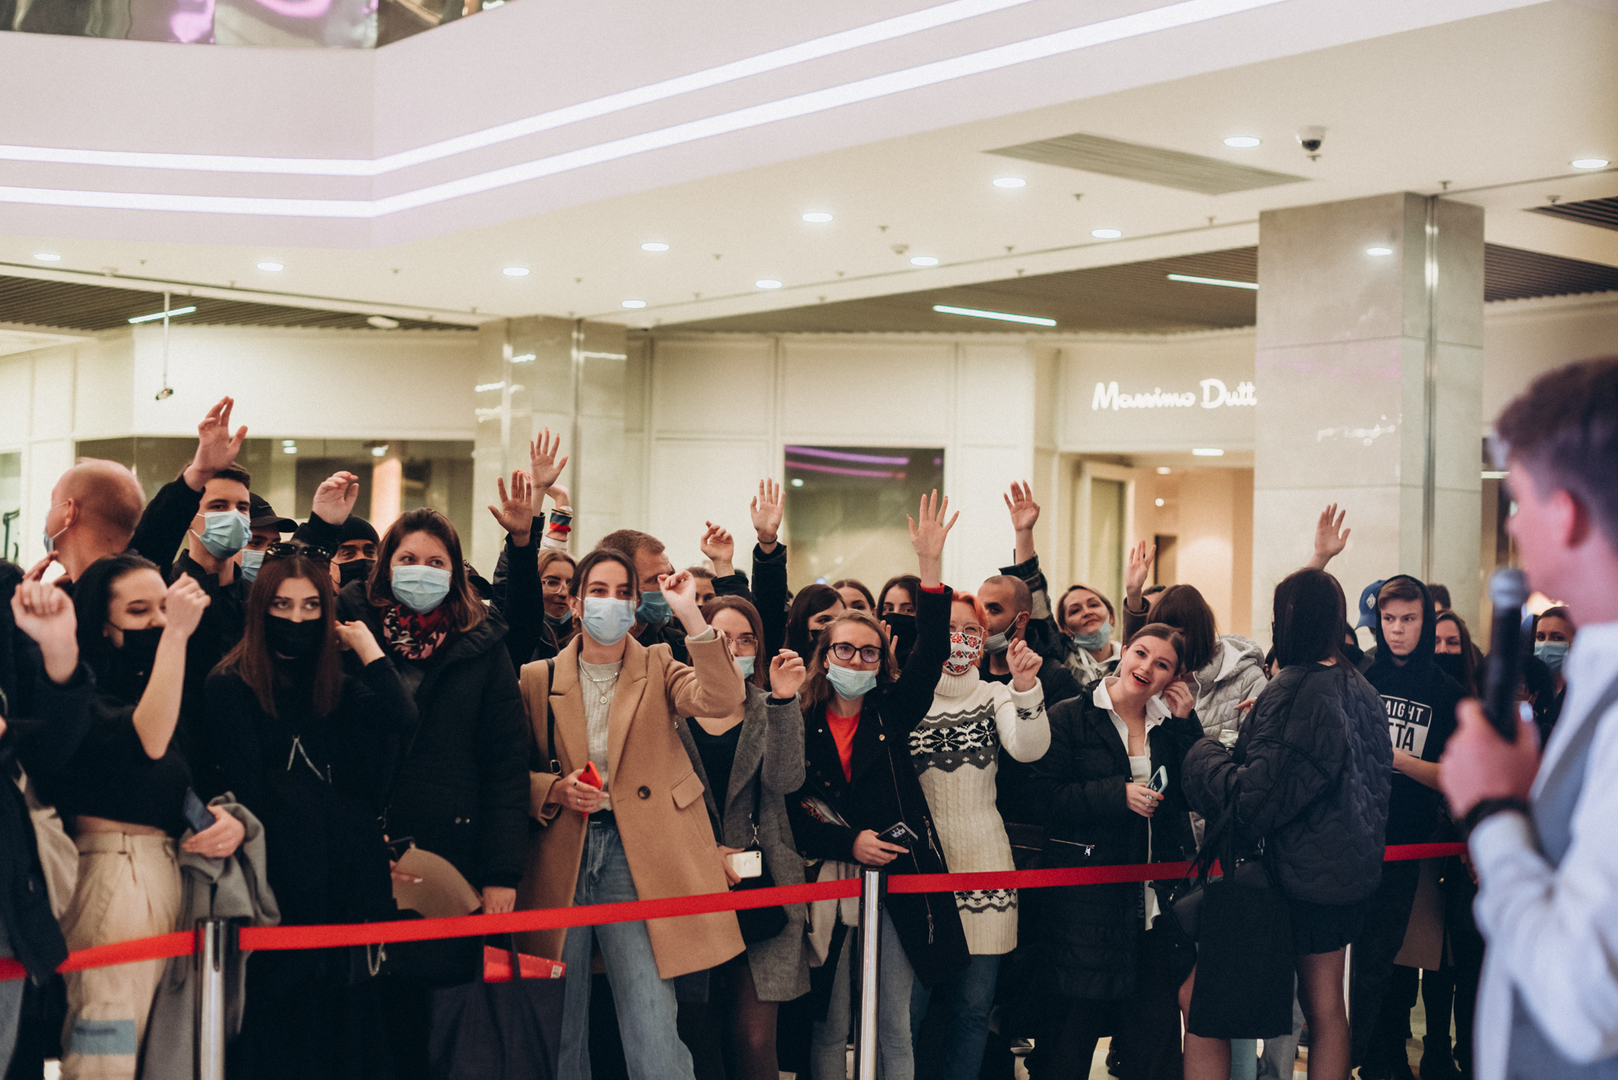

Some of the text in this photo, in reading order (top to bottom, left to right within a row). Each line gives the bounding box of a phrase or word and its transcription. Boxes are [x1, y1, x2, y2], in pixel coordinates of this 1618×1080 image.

[1092, 378, 1258, 411] Massimo Dutt
[1385, 700, 1424, 722] AIGHT
